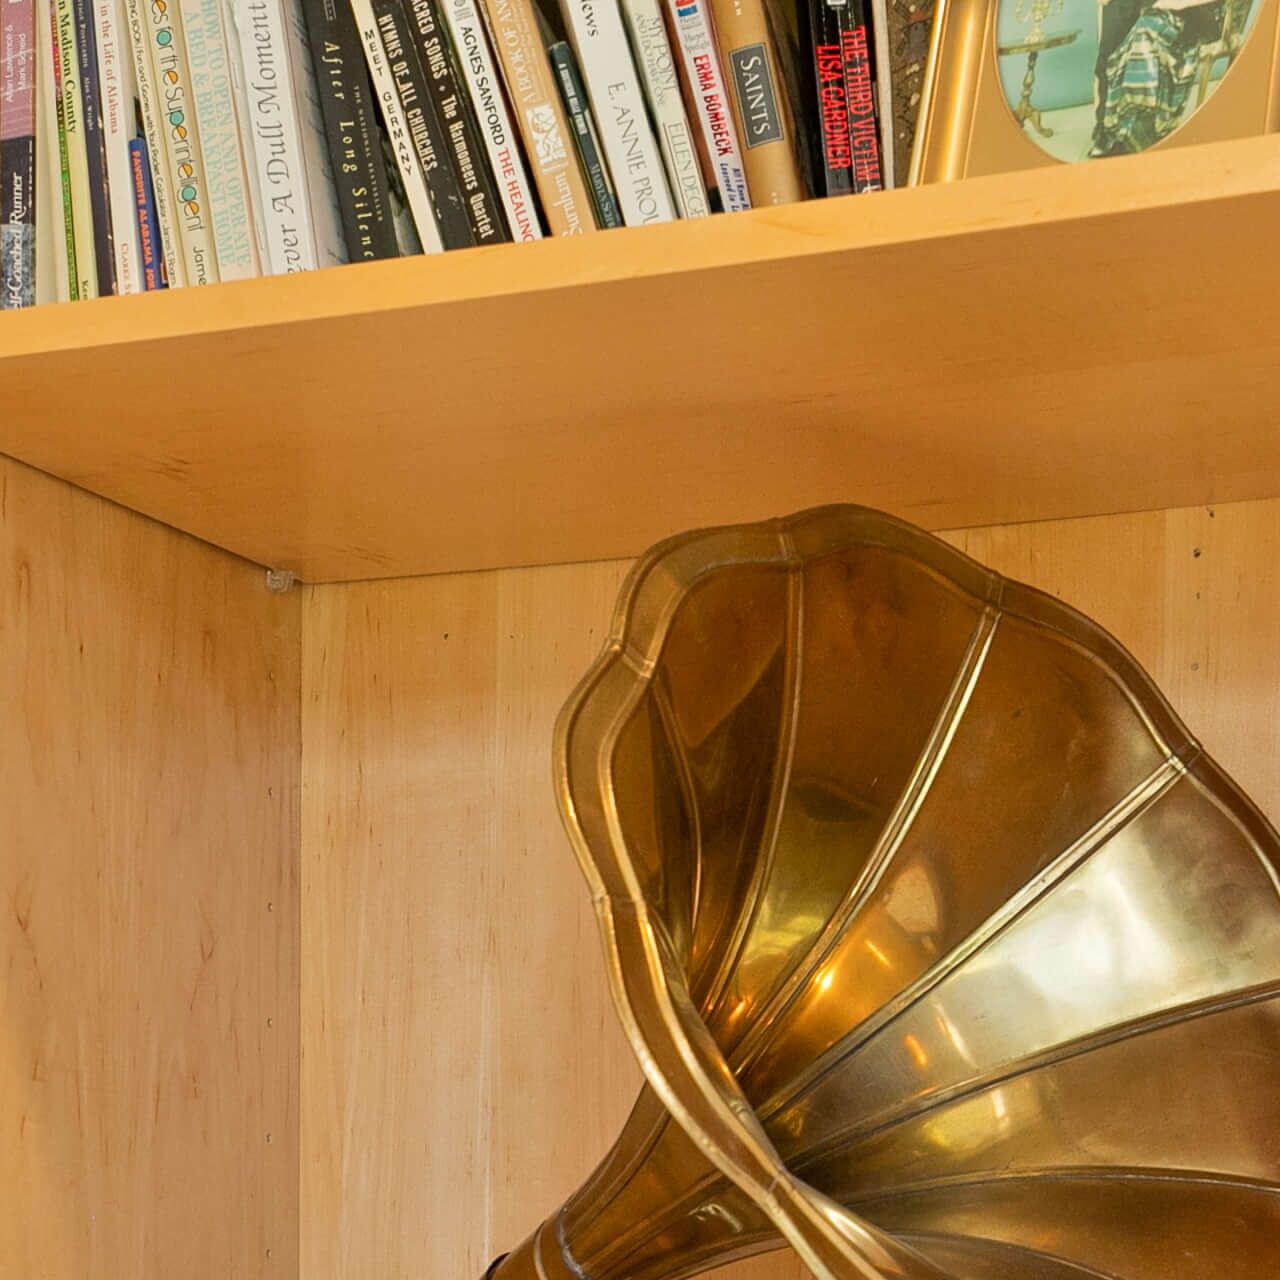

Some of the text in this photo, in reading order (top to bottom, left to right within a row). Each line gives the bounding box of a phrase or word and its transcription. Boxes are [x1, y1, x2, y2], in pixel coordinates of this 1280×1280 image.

[151, 0, 169, 25] es
[377, 14, 403, 59] HYMNS
[501, 27, 520, 48] OF
[580, 0, 599, 38] ews
[59, 14, 73, 77] Madison
[136, 50, 144, 65] Fun
[156, 26, 175, 52] for
[247, 2, 281, 115] Moment
[424, 37, 448, 80] SONGS
[647, 16, 677, 91] MY POINT
[841, 25, 869, 62] THE
[100, 5, 119, 134] in the Life of Alabama
[138, 66, 146, 83] and
[160, 55, 179, 87] the
[397, 79, 418, 107] ALL
[509, 48, 533, 91] BOOK
[606, 81, 627, 100] E.
[692, 53, 718, 91] ERMA
[739, 55, 770, 136] SAINTS
[846, 62, 873, 117] THIRD
[63, 80, 77, 134] County
[141, 85, 151, 113] Games
[321, 40, 347, 101] After
[339, 121, 359, 174] Long
[364, 28, 413, 177] MEET GERMANY
[440, 94, 457, 120] The
[460, 26, 485, 76] AGNES
[476, 76, 505, 147] SANFORD
[497, 147, 516, 179] THE
[703, 93, 734, 157] BOMBECK
[816, 44, 851, 170] LISA GARDNER
[165, 87, 207, 233] Superintelligent
[184, 11, 233, 266] A BED & BREAKFAST HOME
[200, 0, 252, 268] HOW TO OPEN AND OPERATE
[256, 120, 290, 185] Dull
[406, 107, 439, 173] CHURCHES
[448, 120, 480, 190] Harmoneers
[613, 105, 648, 176] ANNIE
[667, 120, 694, 172] ELLEN
[851, 116, 881, 181] VICTIM
[131, 150, 146, 206] FAVORITE
[151, 149, 161, 176] Pocket
[720, 162, 734, 193] Learned
[731, 167, 743, 179] All
[8, 172, 28, 225] Runner
[272, 193, 295, 215] A
[469, 194, 496, 239] Quartet
[736, 184, 747, 203] Know
[138, 208, 153, 265] ALABAMA
